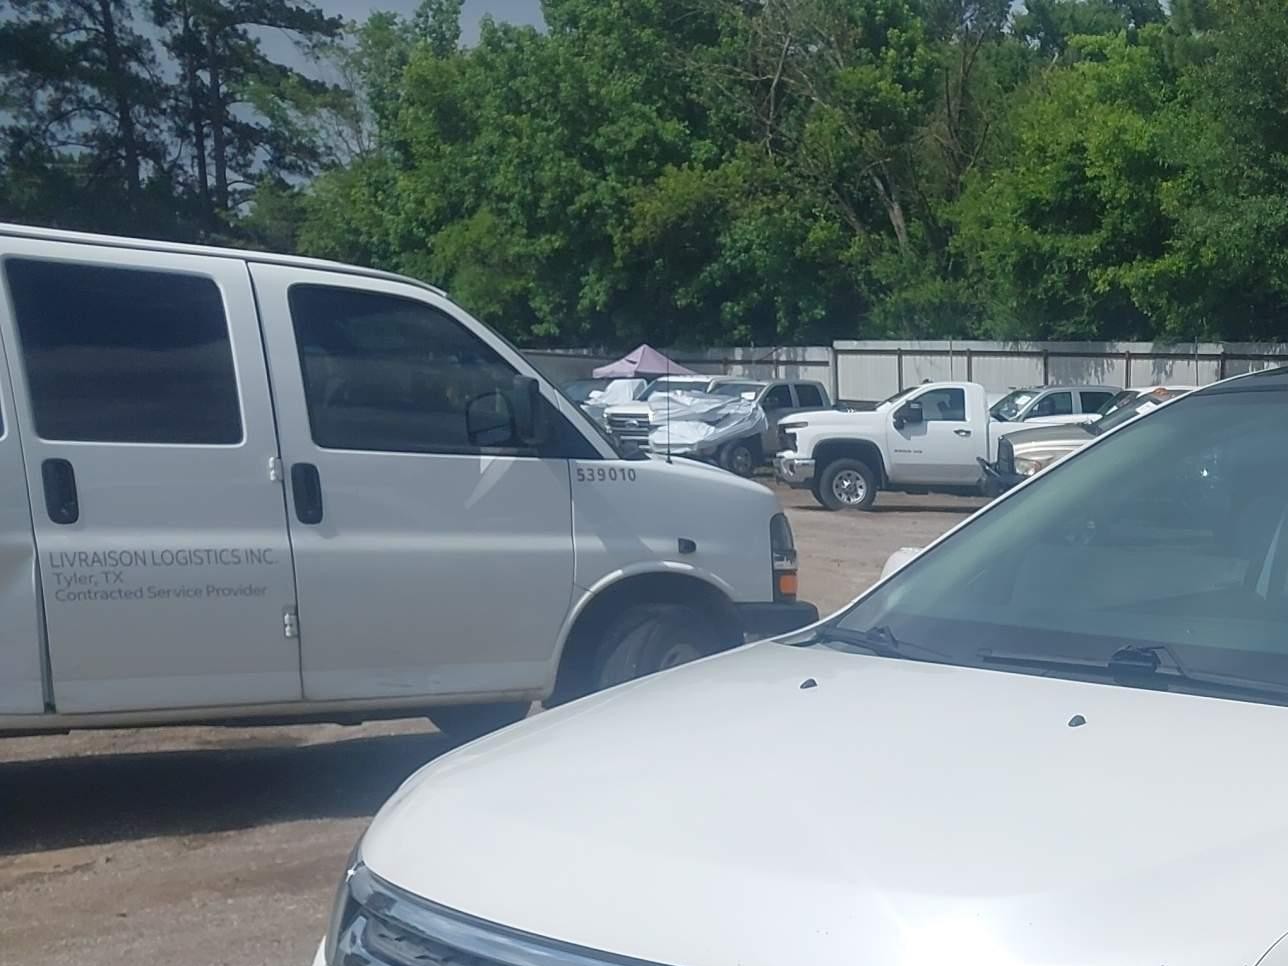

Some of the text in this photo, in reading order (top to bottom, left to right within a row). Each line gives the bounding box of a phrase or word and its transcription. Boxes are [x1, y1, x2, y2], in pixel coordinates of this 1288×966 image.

[576, 467, 637, 482] 539010
[50, 548, 280, 568] LIVRAISON LOGISTICS INC.
[53, 570, 125, 588] Tyler, TX
[55, 583, 268, 602] Contracted Service Provider
